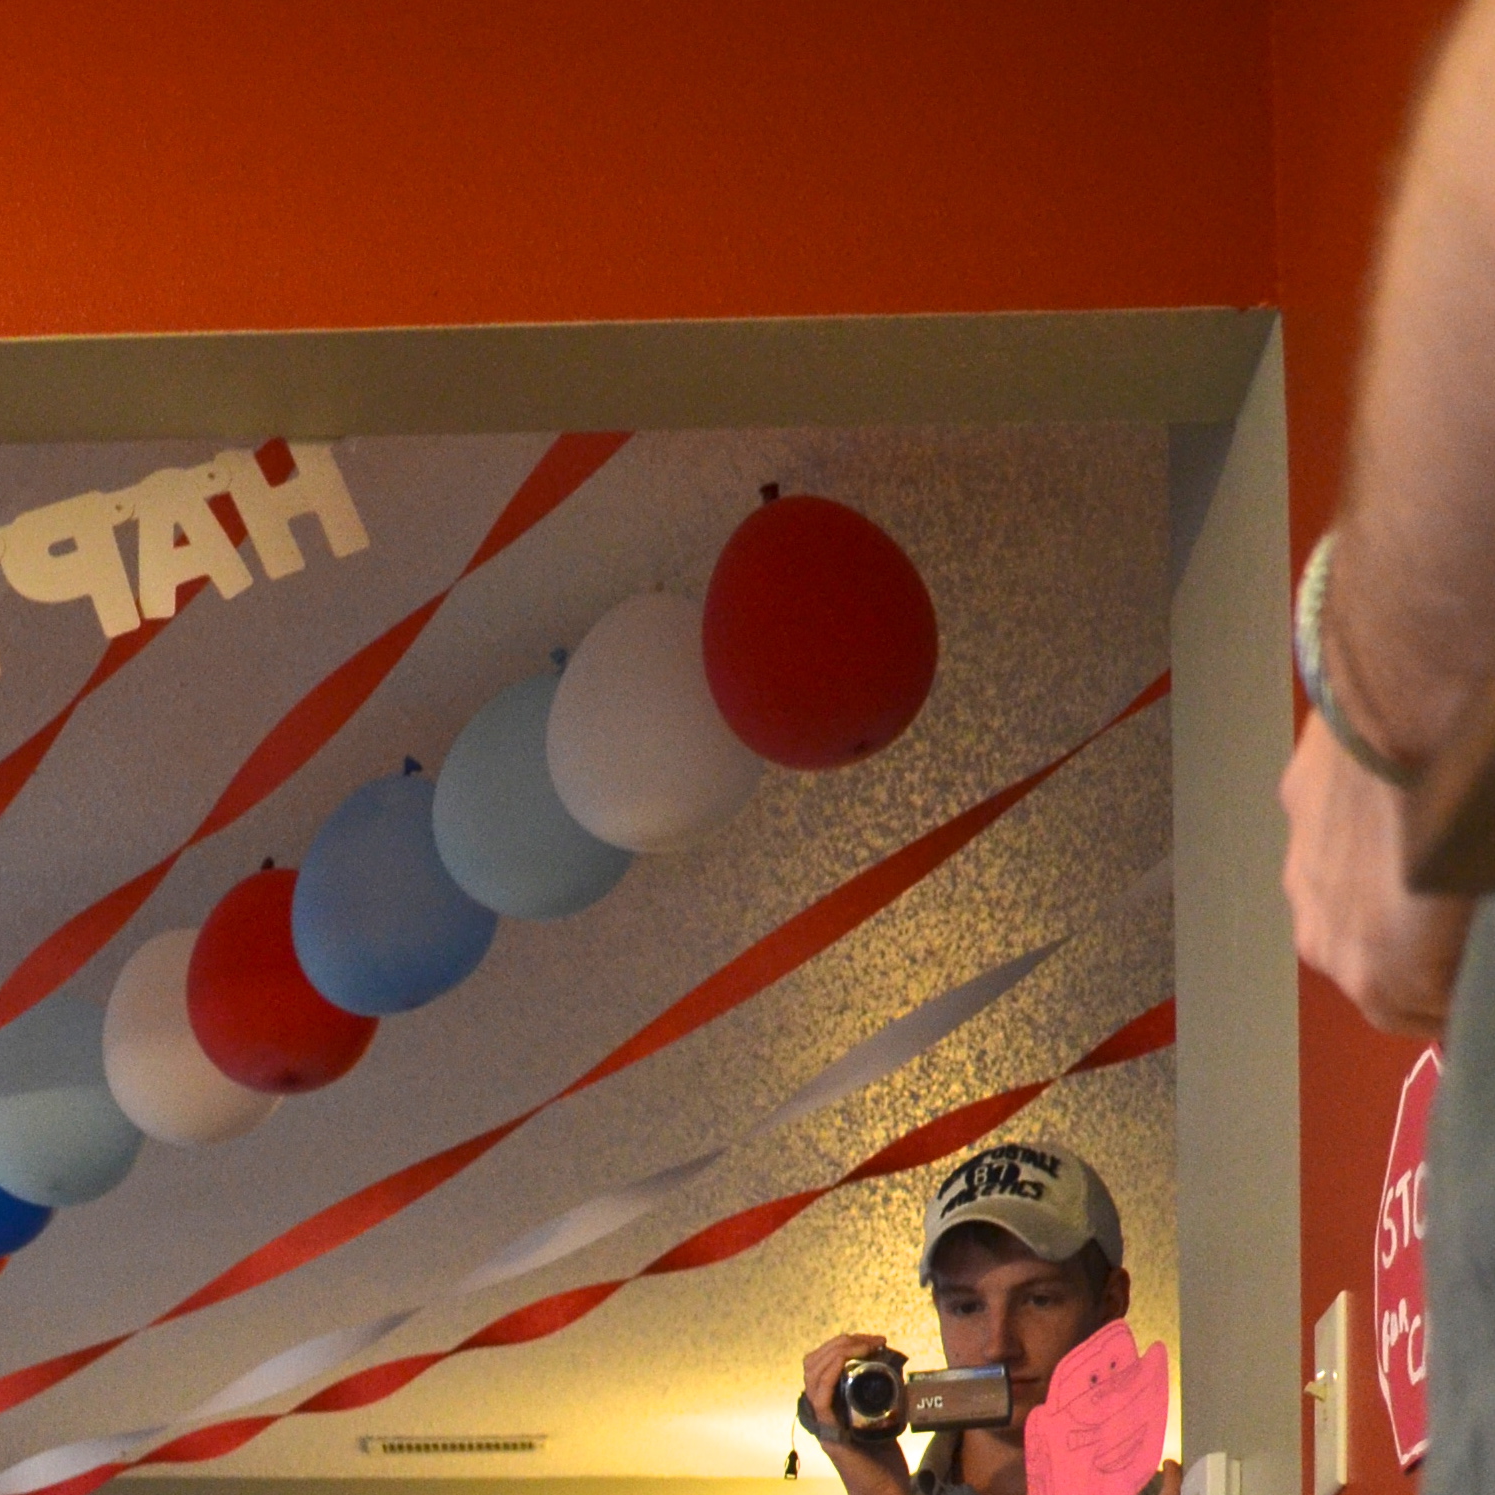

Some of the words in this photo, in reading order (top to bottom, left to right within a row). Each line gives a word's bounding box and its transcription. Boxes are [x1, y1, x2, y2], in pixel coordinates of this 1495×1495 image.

[972, 1162, 1008, 1187] 87
[1382, 1161, 1427, 1270] STO
[1407, 1314, 1426, 1386] C
[916, 1396, 943, 1410] JVC
